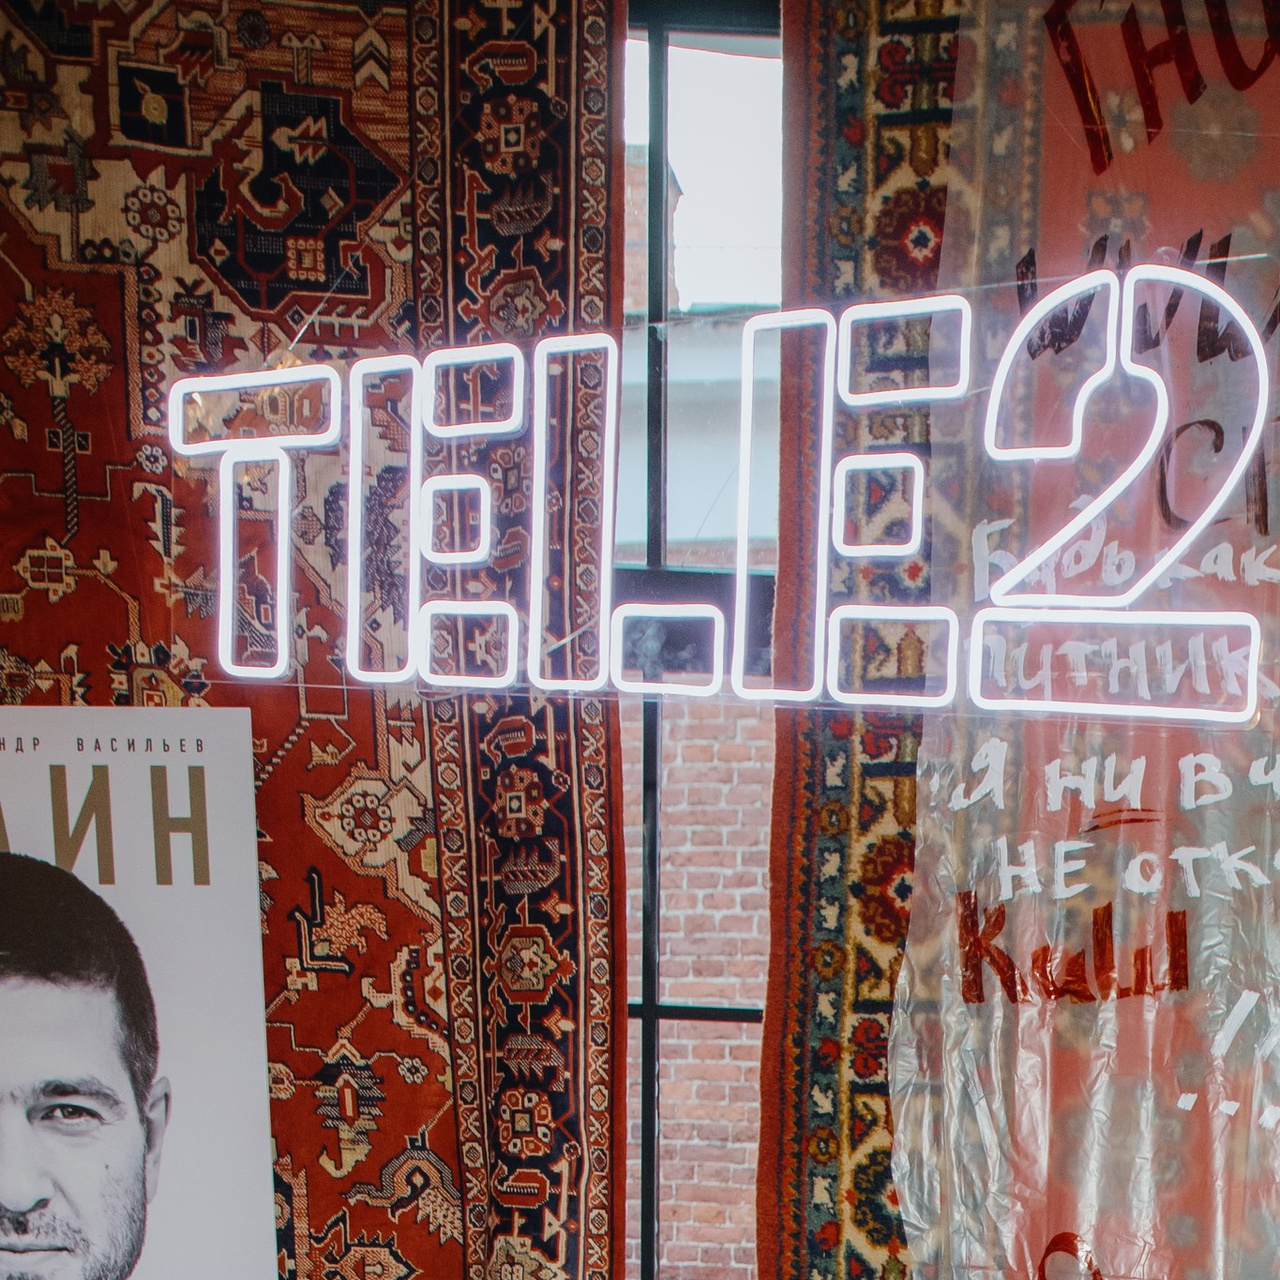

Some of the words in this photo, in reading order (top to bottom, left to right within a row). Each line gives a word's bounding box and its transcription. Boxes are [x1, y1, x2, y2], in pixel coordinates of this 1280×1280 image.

[168, 260, 1272, 725] TELE2
[76, 737, 205, 753] ВАСИЛЬЕВ
[948, 738, 1009, 811] Я
[0, 764, 211, 886] ИН
